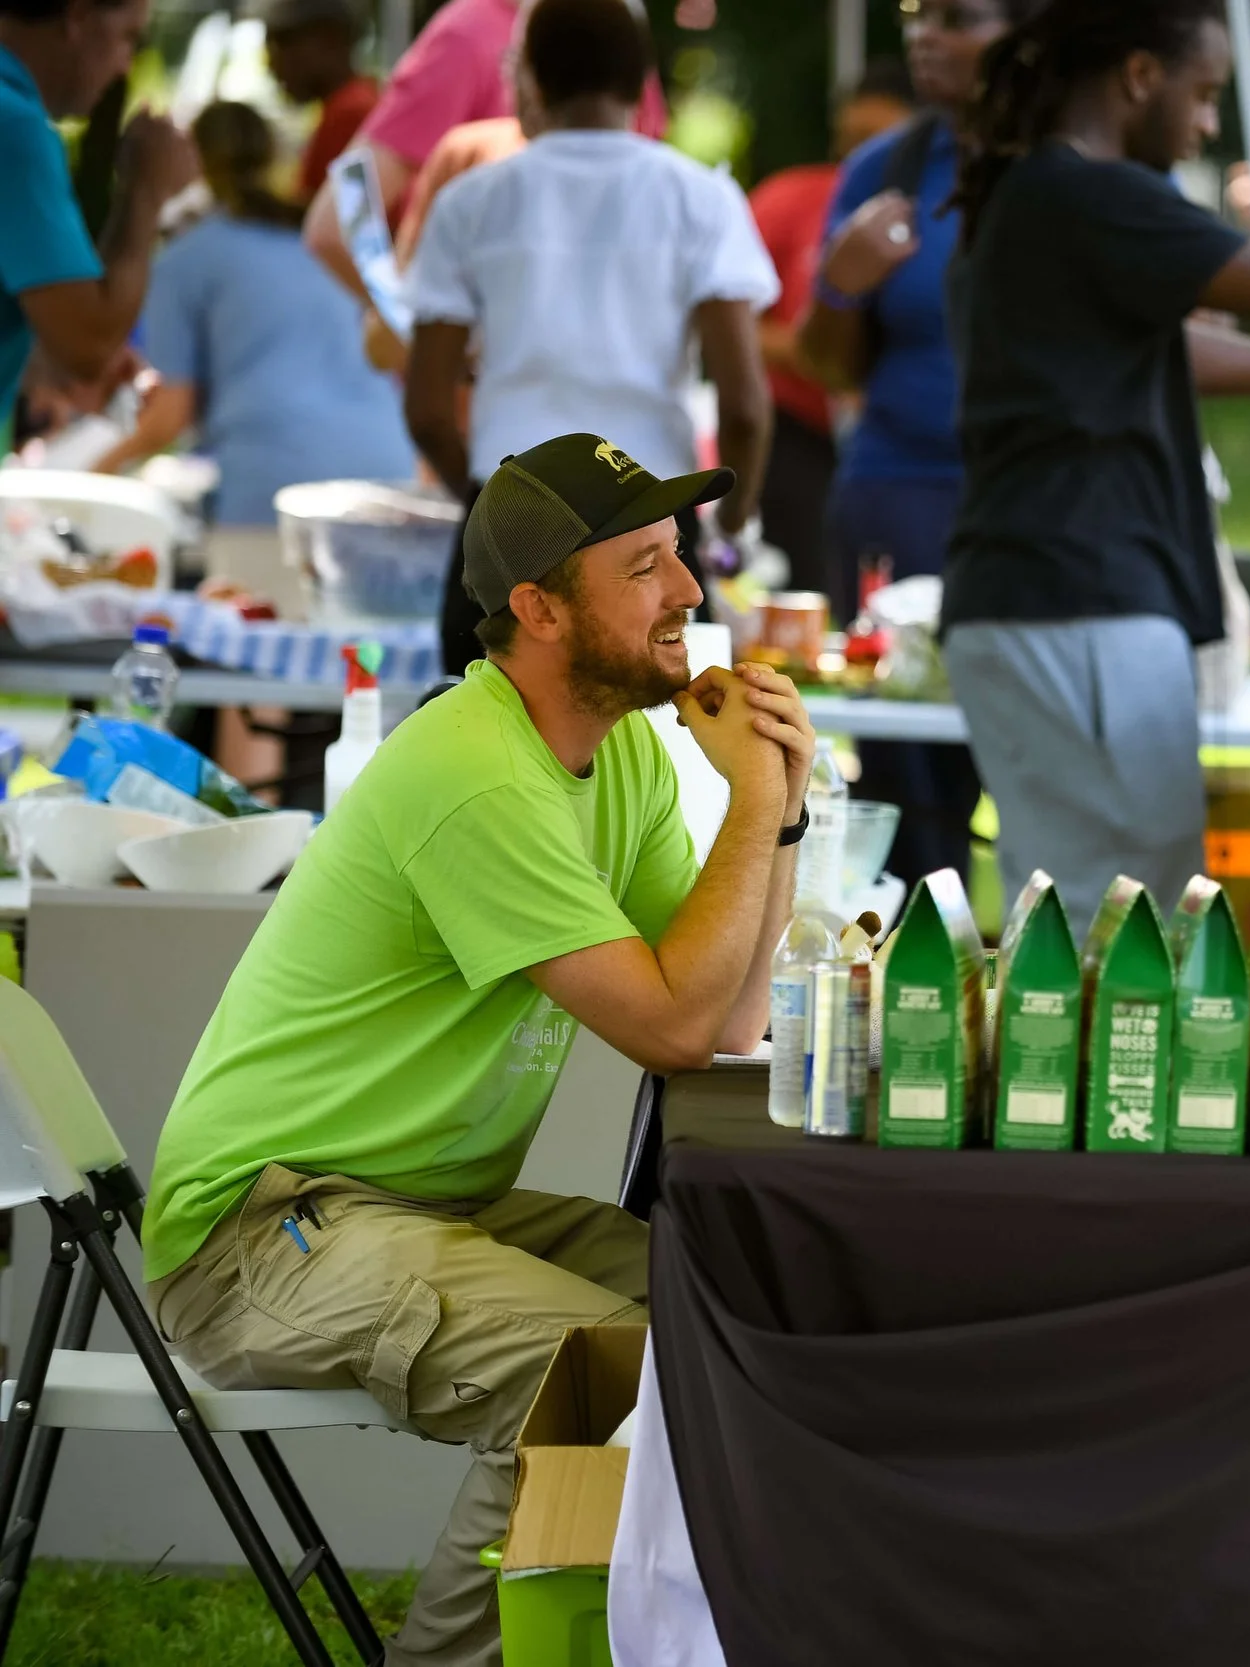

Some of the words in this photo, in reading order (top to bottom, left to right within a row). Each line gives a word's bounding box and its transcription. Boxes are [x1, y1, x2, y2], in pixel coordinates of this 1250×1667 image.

[1112, 1017, 1140, 1034] WET
[1110, 1034, 1158, 1051] NOSES
[1109, 1063, 1155, 1076] KISSES
